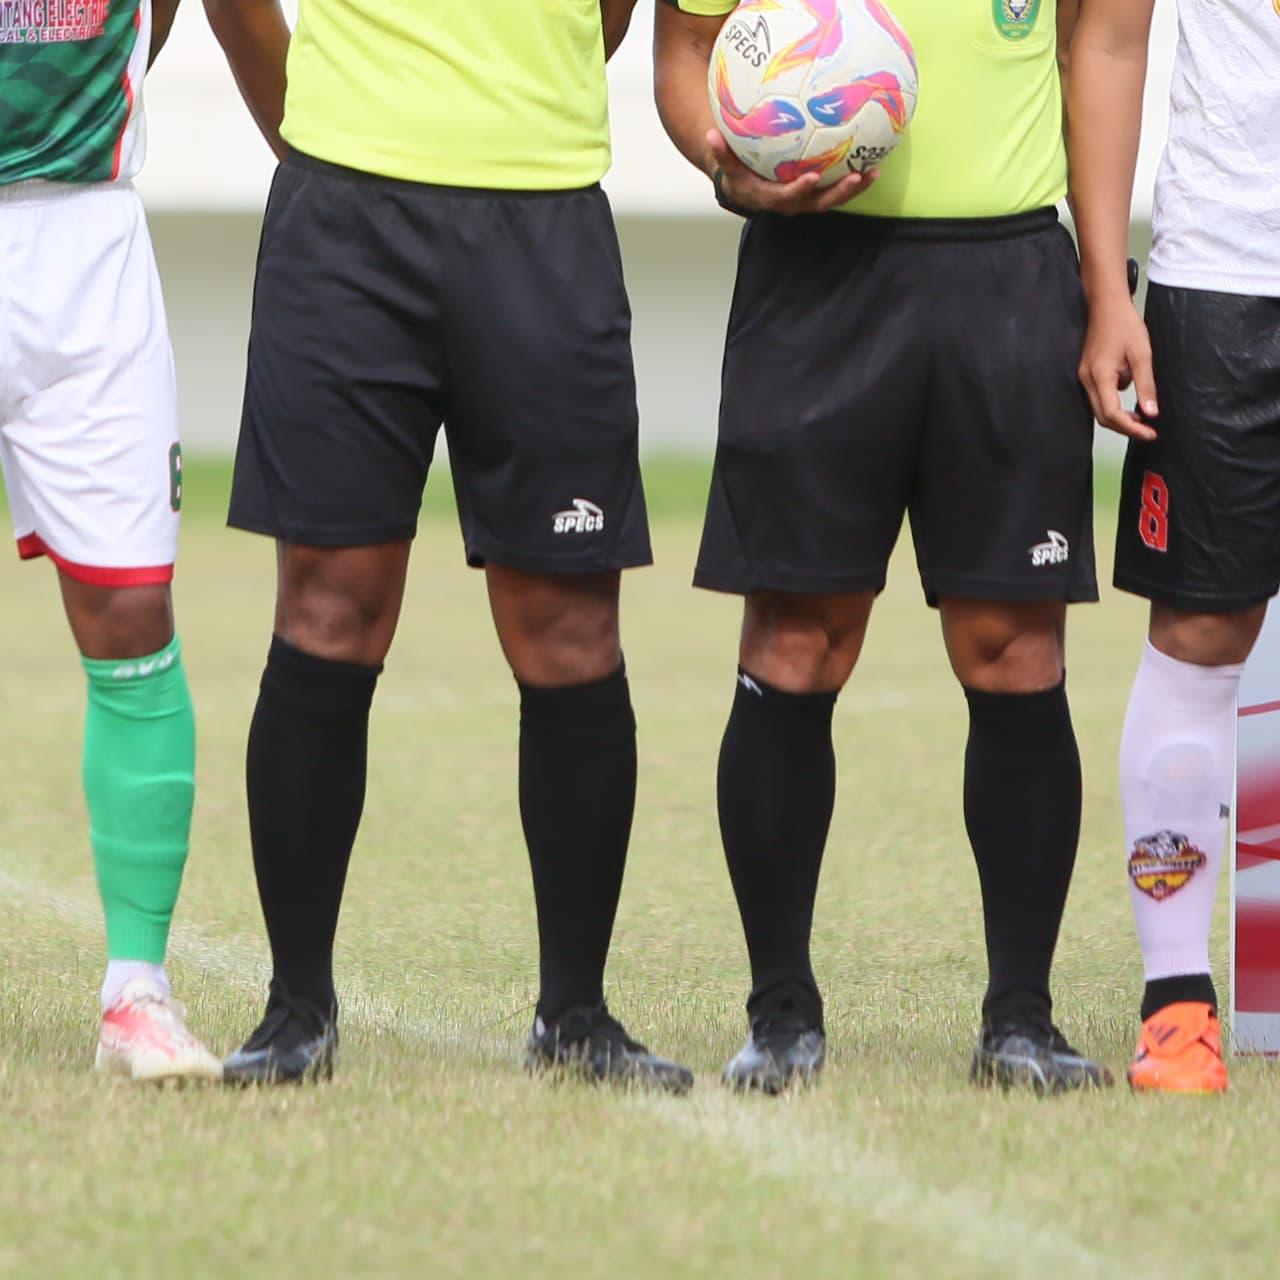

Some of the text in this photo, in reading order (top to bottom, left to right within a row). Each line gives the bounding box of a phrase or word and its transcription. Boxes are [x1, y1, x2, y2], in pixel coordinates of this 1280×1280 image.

[26, 27, 39, 43] &
[724, 23, 767, 68] SPECS
[1139, 469, 1169, 553] 8
[553, 515, 604, 533] SPECS
[1031, 548, 1069, 566] SPECS
